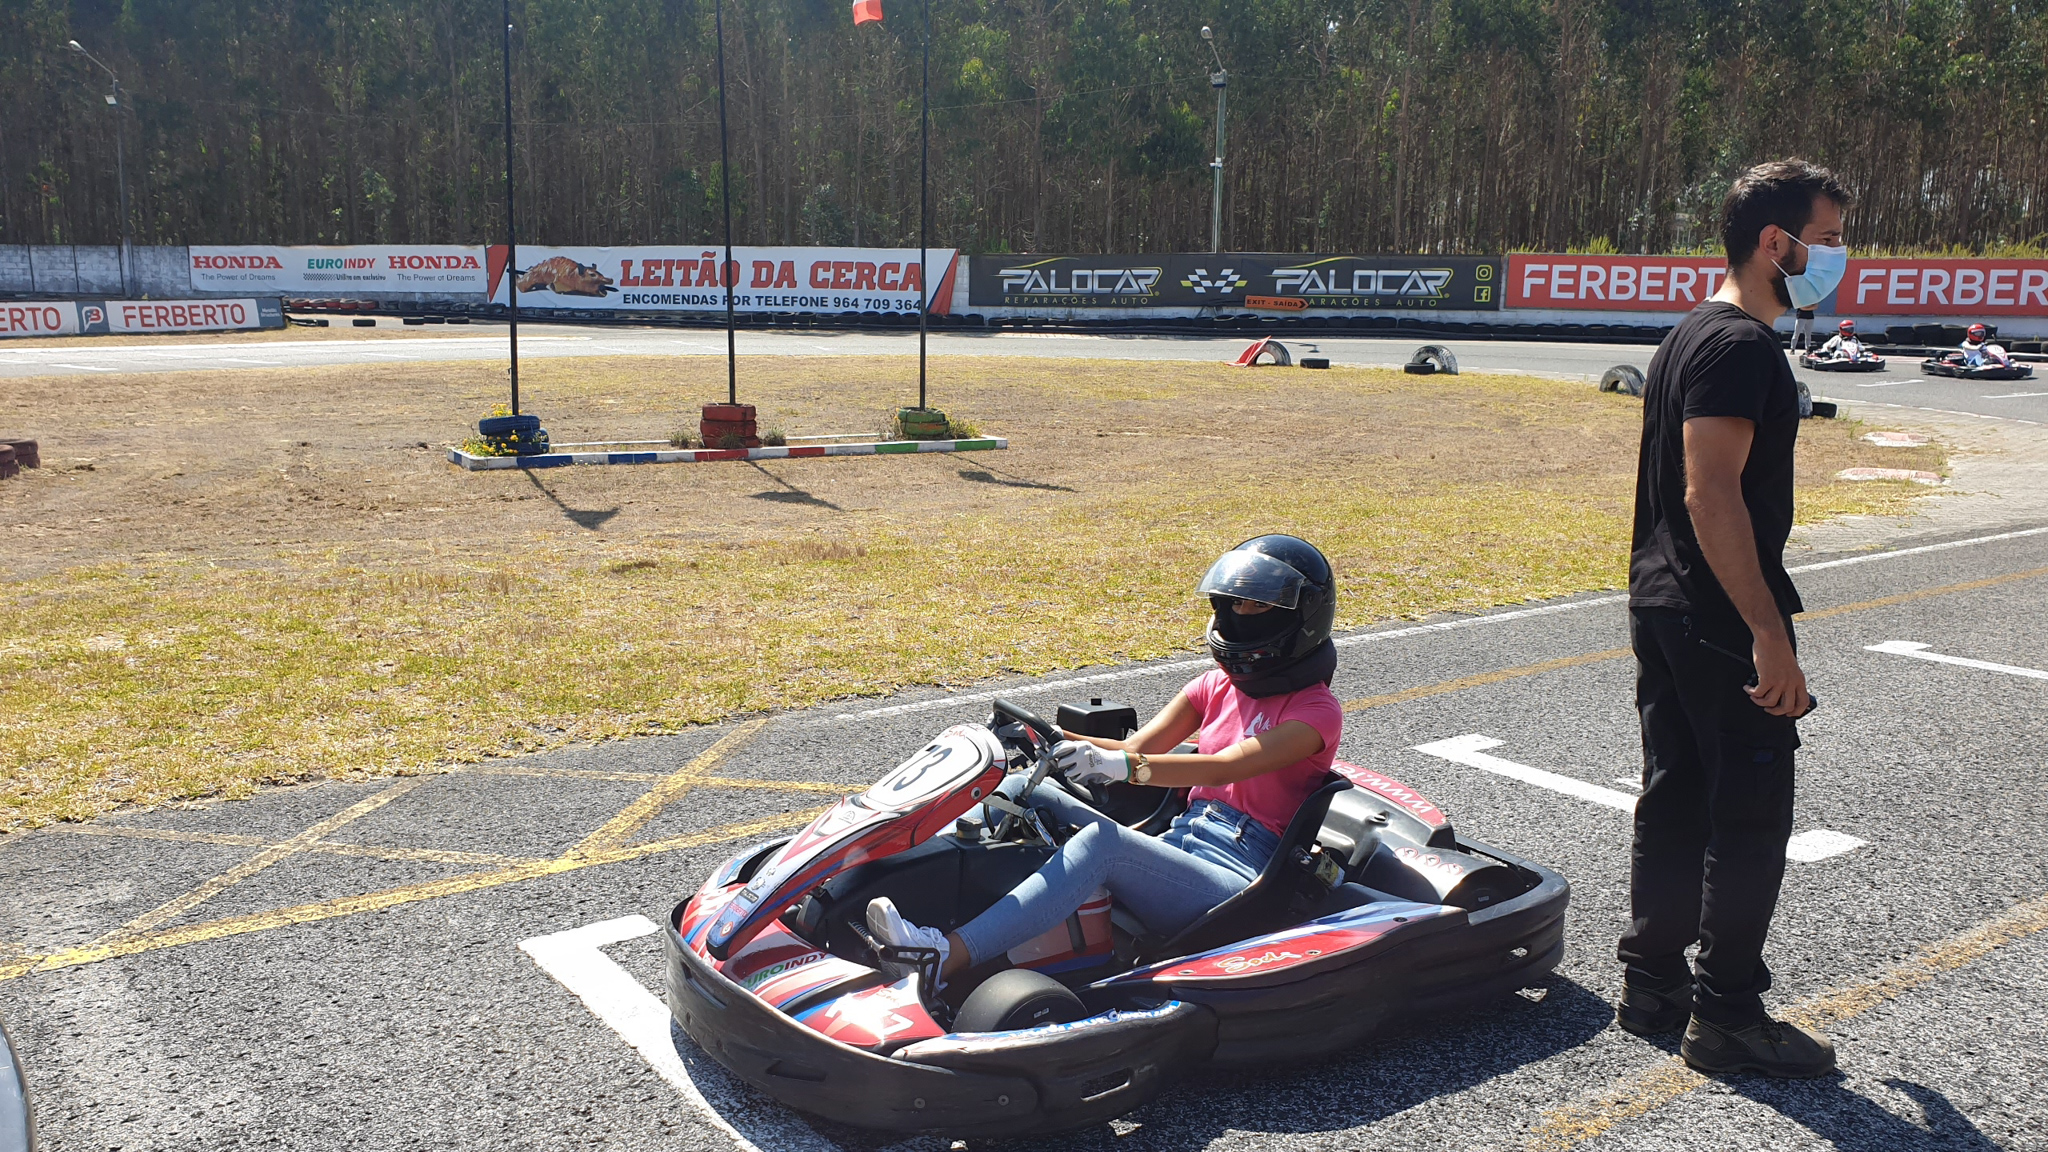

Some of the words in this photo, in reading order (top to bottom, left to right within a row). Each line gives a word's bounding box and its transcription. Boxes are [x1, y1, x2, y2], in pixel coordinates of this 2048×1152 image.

[192, 255, 283, 269] HONDA
[307, 258, 376, 269] EUROINDY
[388, 255, 481, 270] HONDA
[240, 273, 248, 281] of
[446, 274, 476, 282] Dreams
[619, 251, 741, 288] LEITÃO
[750, 260, 798, 289] DA
[809, 260, 922, 292] CERCA
[998, 268, 1161, 294] PALOCAR
[1270, 268, 1452, 295] PALOCAR
[1522, 263, 1727, 302] FERBERT
[1856, 268, 2048, 306] FERBER
[623, 294, 718, 306] ENCOMENDAS
[722, 295, 751, 307] POR
[755, 295, 829, 308] TELEFONE
[833, 297, 860, 309] 964
[863, 298, 890, 310] 709
[895, 299, 922, 311] 364
[1004, 296, 1097, 305] REPARAÇÕES
[1110, 297, 1149, 305] AUTO
[1308, 297, 1381, 307] ARAÇÕES
[1395, 299, 1437, 307] AUTO
[122, 303, 246, 328] FERBERTO
